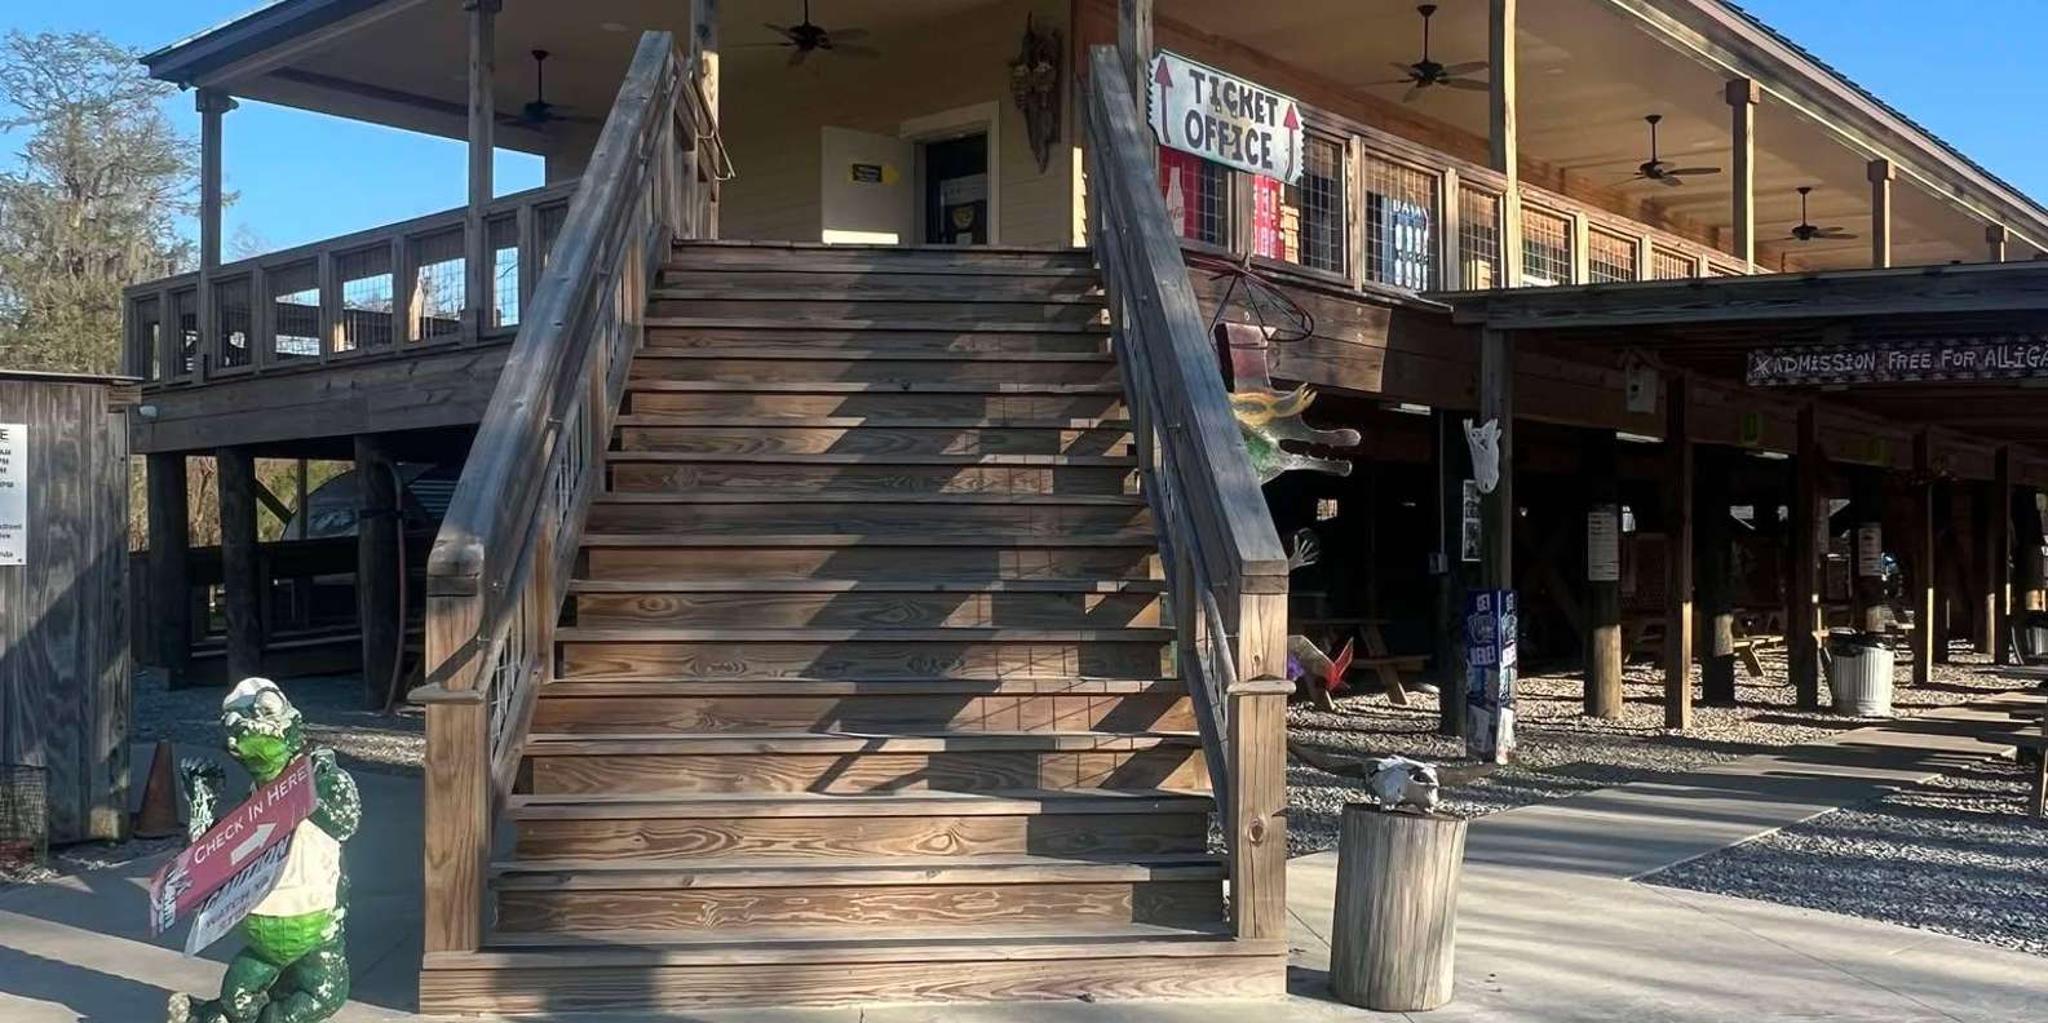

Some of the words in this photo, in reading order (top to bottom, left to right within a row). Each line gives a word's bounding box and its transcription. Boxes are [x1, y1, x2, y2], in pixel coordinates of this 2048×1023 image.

[1189, 69, 1279, 127] TICKET
[1184, 109, 1274, 169] OFFICE
[1888, 350, 1932, 370] FREE
[1941, 348, 1976, 368] FOR
[194, 817, 245, 864] CHECK
[249, 800, 264, 822] IN
[267, 765, 309, 807] HERE
